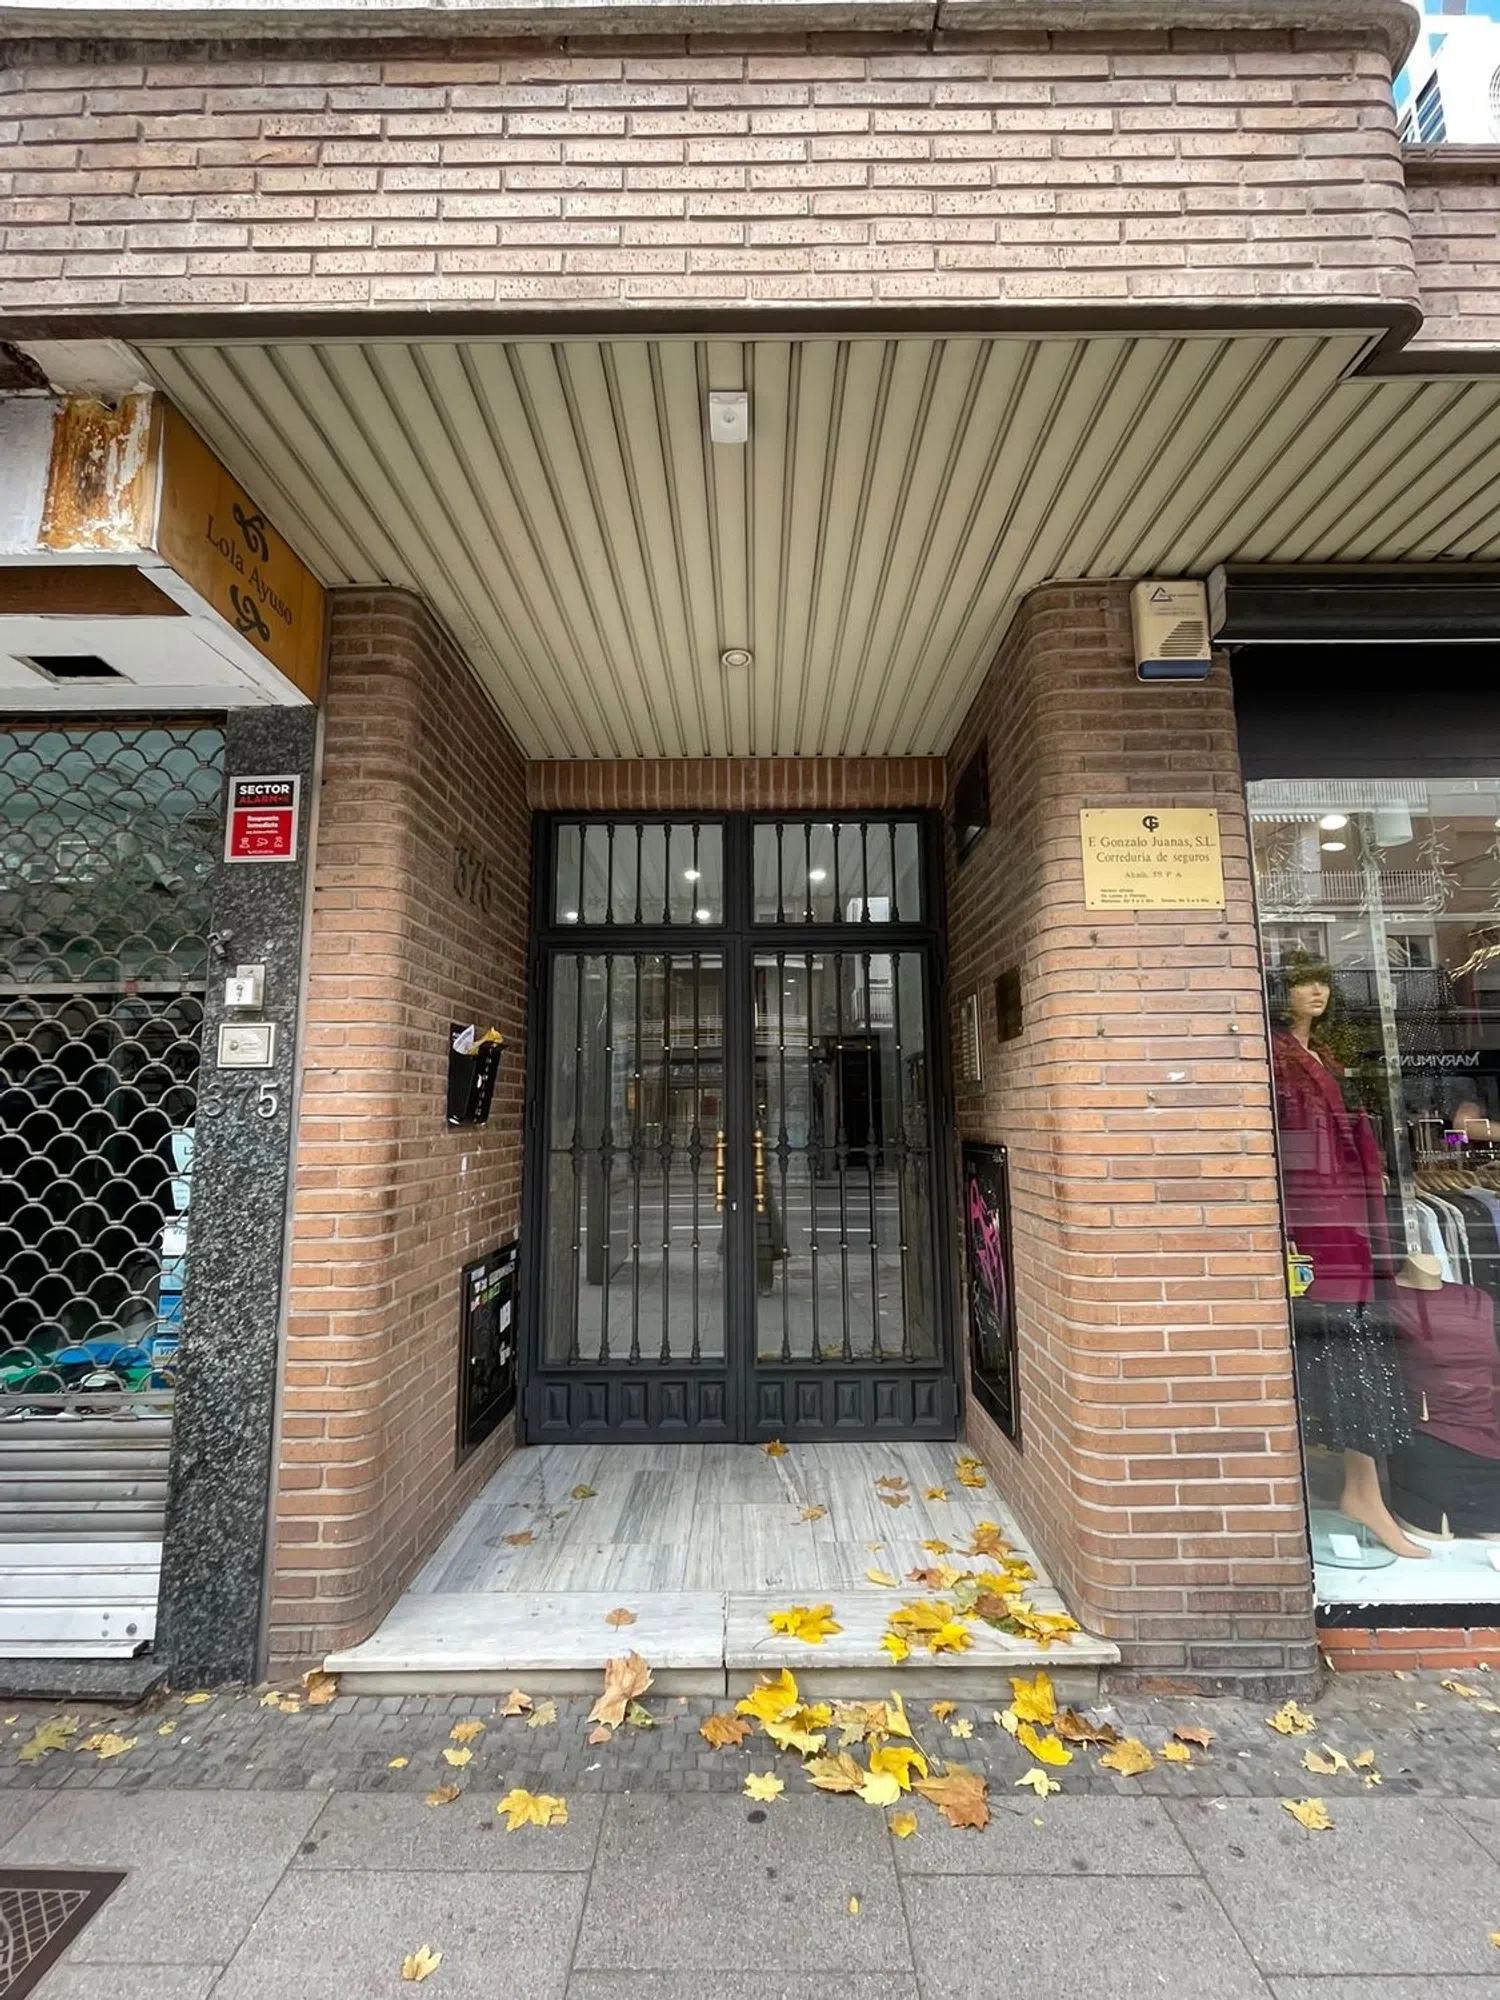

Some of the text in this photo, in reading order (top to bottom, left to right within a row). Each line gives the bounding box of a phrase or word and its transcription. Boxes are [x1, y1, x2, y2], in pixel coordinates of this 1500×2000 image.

[205, 513, 293, 625] Lola Ayuso
[239, 784, 291, 795] SECTOR
[1100, 836, 1148, 848] Gonzalo
[1151, 836, 1193, 849] Juanas,
[1156, 852, 1168, 863] de
[1173, 853, 1210, 865] seguros
[203, 1082, 280, 1120] 375
